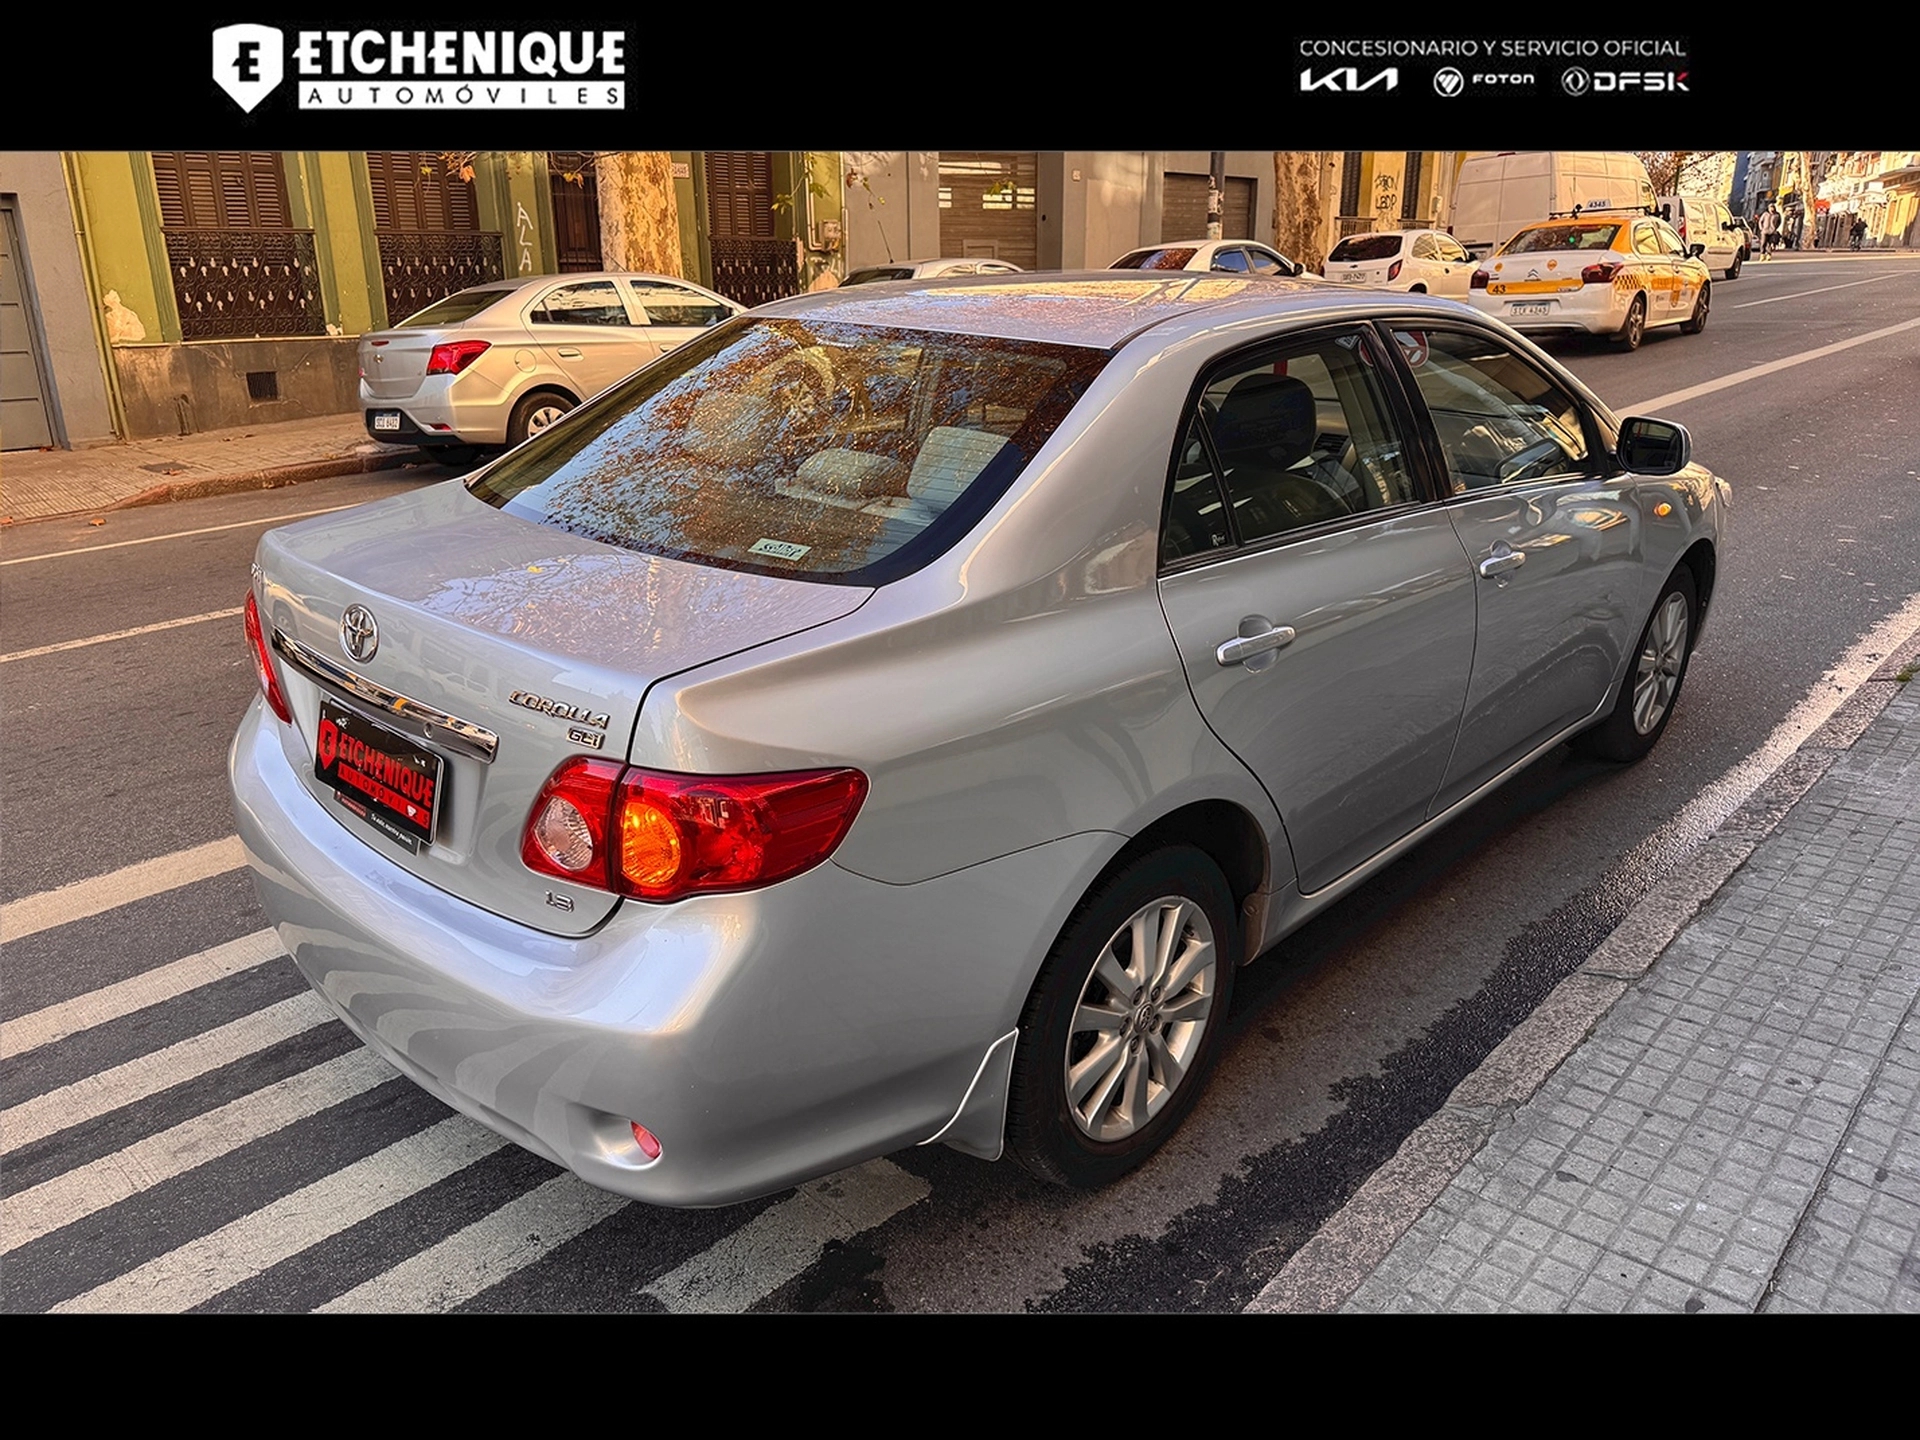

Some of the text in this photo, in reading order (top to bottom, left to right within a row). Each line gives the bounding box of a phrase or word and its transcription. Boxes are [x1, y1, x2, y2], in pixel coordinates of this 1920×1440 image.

[1493, 284, 1506, 294] 43
[509, 690, 610, 730] COROLLA
[339, 733, 434, 808] ETCHENIQUE
